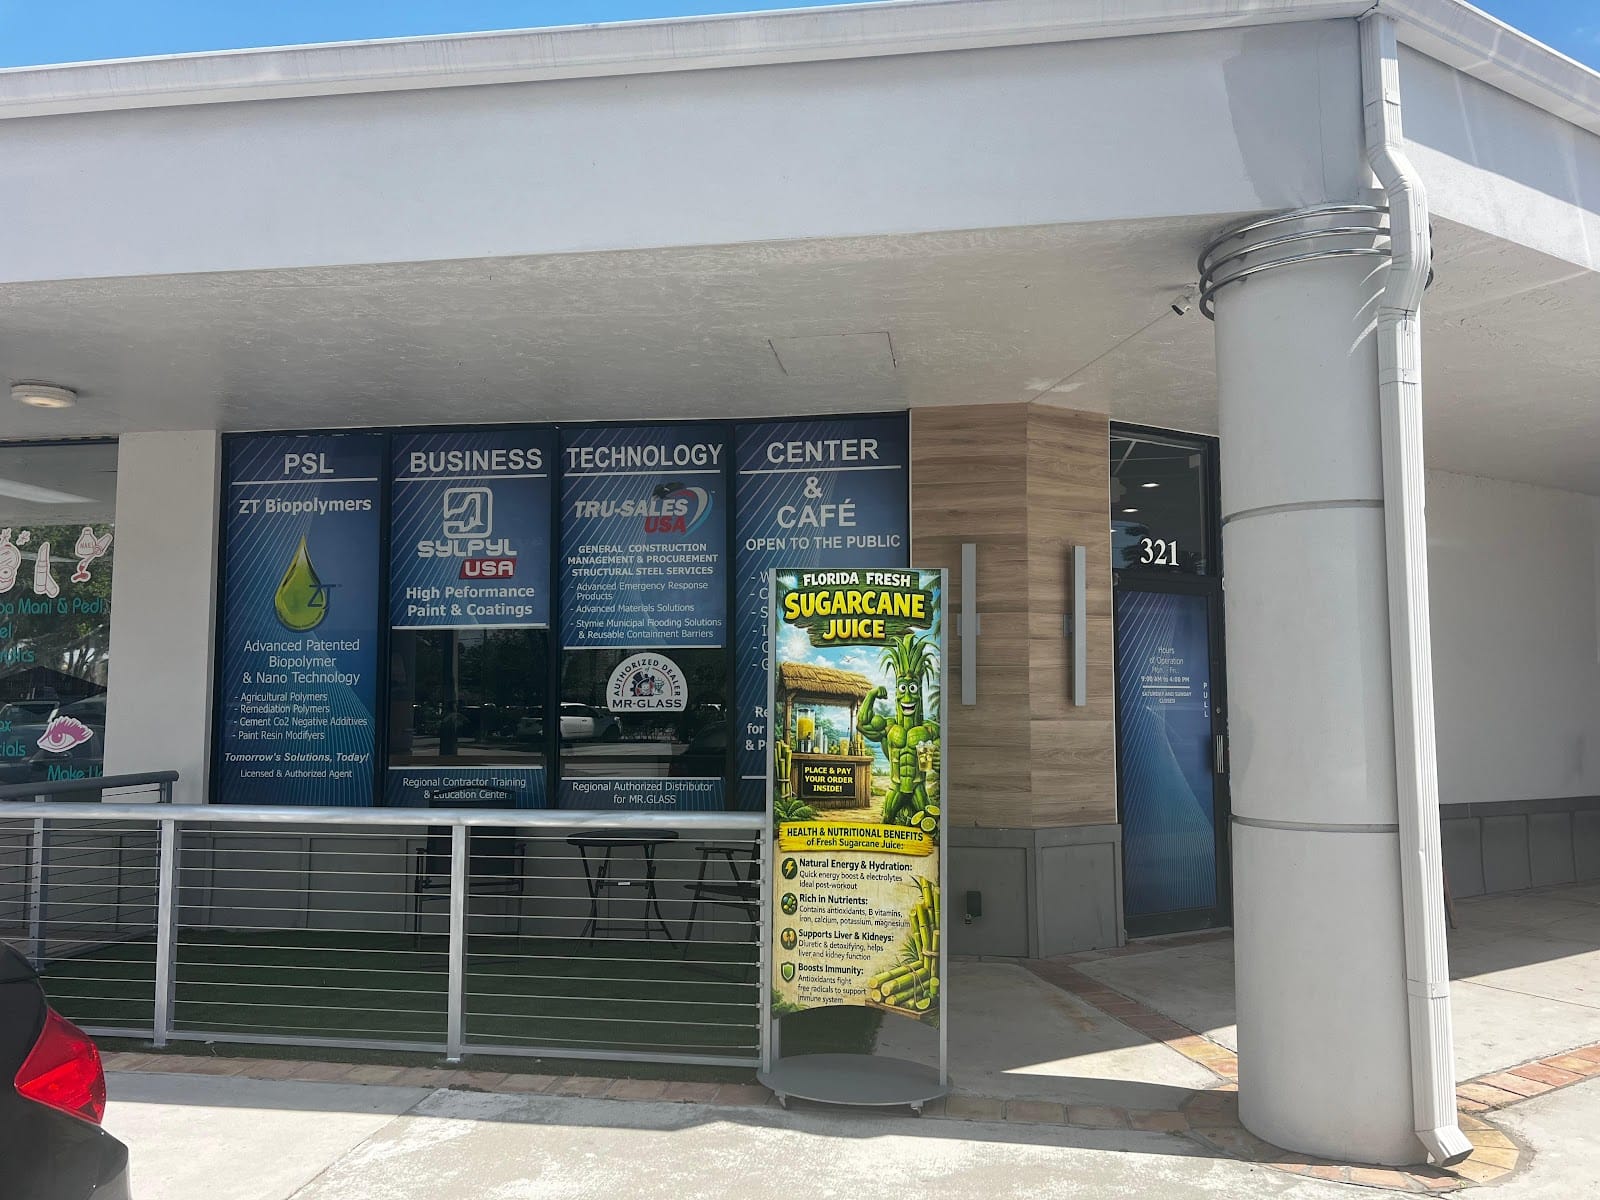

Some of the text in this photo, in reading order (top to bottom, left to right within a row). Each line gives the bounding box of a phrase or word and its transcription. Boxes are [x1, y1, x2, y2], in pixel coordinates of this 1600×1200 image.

[566, 444, 723, 468] TECHNOLOGY
[767, 439, 879, 463] CENTER
[284, 453, 334, 474] PSL
[410, 449, 542, 472] BUSINESS
[804, 477, 823, 498] &
[239, 497, 372, 515] ZT Biopolymers
[575, 499, 688, 517] TRU-SALES
[777, 499, 856, 528] CAFÉ
[644, 516, 687, 534] USA
[418, 539, 517, 557] SYLPYL
[746, 535, 900, 550] OPEN TO THE PUBLIC
[579, 544, 707, 553] GENERAL CONSTRUCTION
[1141, 537, 1180, 566] 321
[568, 556, 633, 564] MANAGEMENT
[647, 554, 718, 563] PROCUREMENT
[465, 561, 514, 576] USA
[572, 568, 633, 576] STRUCTURAL
[803, 572, 911, 587] FLORIDA FRESH
[620, 582, 665, 592] Emergency
[668, 582, 708, 591] Response
[406, 586, 534, 601] High Peformance
[408, 603, 532, 617] Paint & Coatings
[619, 604, 654, 612] Materials
[784, 590, 925, 619] SUGARCANE
[607, 620, 644, 628] Municipal
[648, 619, 681, 627] Flooding
[684, 618, 722, 626] Solutions
[823, 619, 885, 640] JUICE
[244, 639, 360, 652] Advanced Patented
[269, 656, 336, 669] Biopolymer
[243, 672, 360, 685] & Nano Technology
[614, 659, 659, 696] AUTHORIZED
[662, 664, 680, 696] DEALER
[241, 692, 327, 703] Agricultural Polymers
[240, 705, 330, 714] Remediation Polymers
[613, 700, 681, 708] MR-GLASS
[240, 717, 271, 726] Cement
[292, 718, 328, 727] Negative
[331, 717, 367, 725] Additives
[238, 732, 258, 740] Paint
[225, 753, 369, 763] Tomorrow's Solutions, Today!
[241, 770, 274, 778] Licensed
[285, 770, 326, 778] Authorized
[329, 771, 352, 779] Agent
[827, 776, 853, 784] ORDER
[403, 778, 526, 788] Regional Contractor Training
[572, 782, 712, 792] Regional Authorized Distributor
[614, 795, 676, 804] for MR.GLASS
[787, 828, 923, 841] HEALTH & NUTRITIONAL BENEFITS
[807, 838, 814, 846] of
[839, 839, 879, 849] Sugarcane
[881, 841, 903, 849] Juice:
[800, 859, 829, 867] Natural
[831, 861, 859, 871] Energy
[869, 862, 912, 872] Hydration:
[819, 872, 840, 880] energy
[866, 873, 902, 882] electrolytes
[816, 882, 857, 890] post-workout
[800, 894, 816, 902] Rich
[828, 896, 868, 905] Nutrients:
[800, 906, 825, 914] Contains
[875, 920, 910, 928] magnesium
[799, 929, 894, 942] Supports Liver & Kidneys:
[799, 940, 822, 948] Diuretic
[825, 951, 845, 960] kidney
[846, 952, 870, 960] function
[798, 963, 863, 975] Boosts Immunity:
[798, 975, 852, 986] Antioxidants fight
[811, 985, 833, 993] radicals
[843, 988, 866, 996] support
[823, 996, 843, 1004] system
